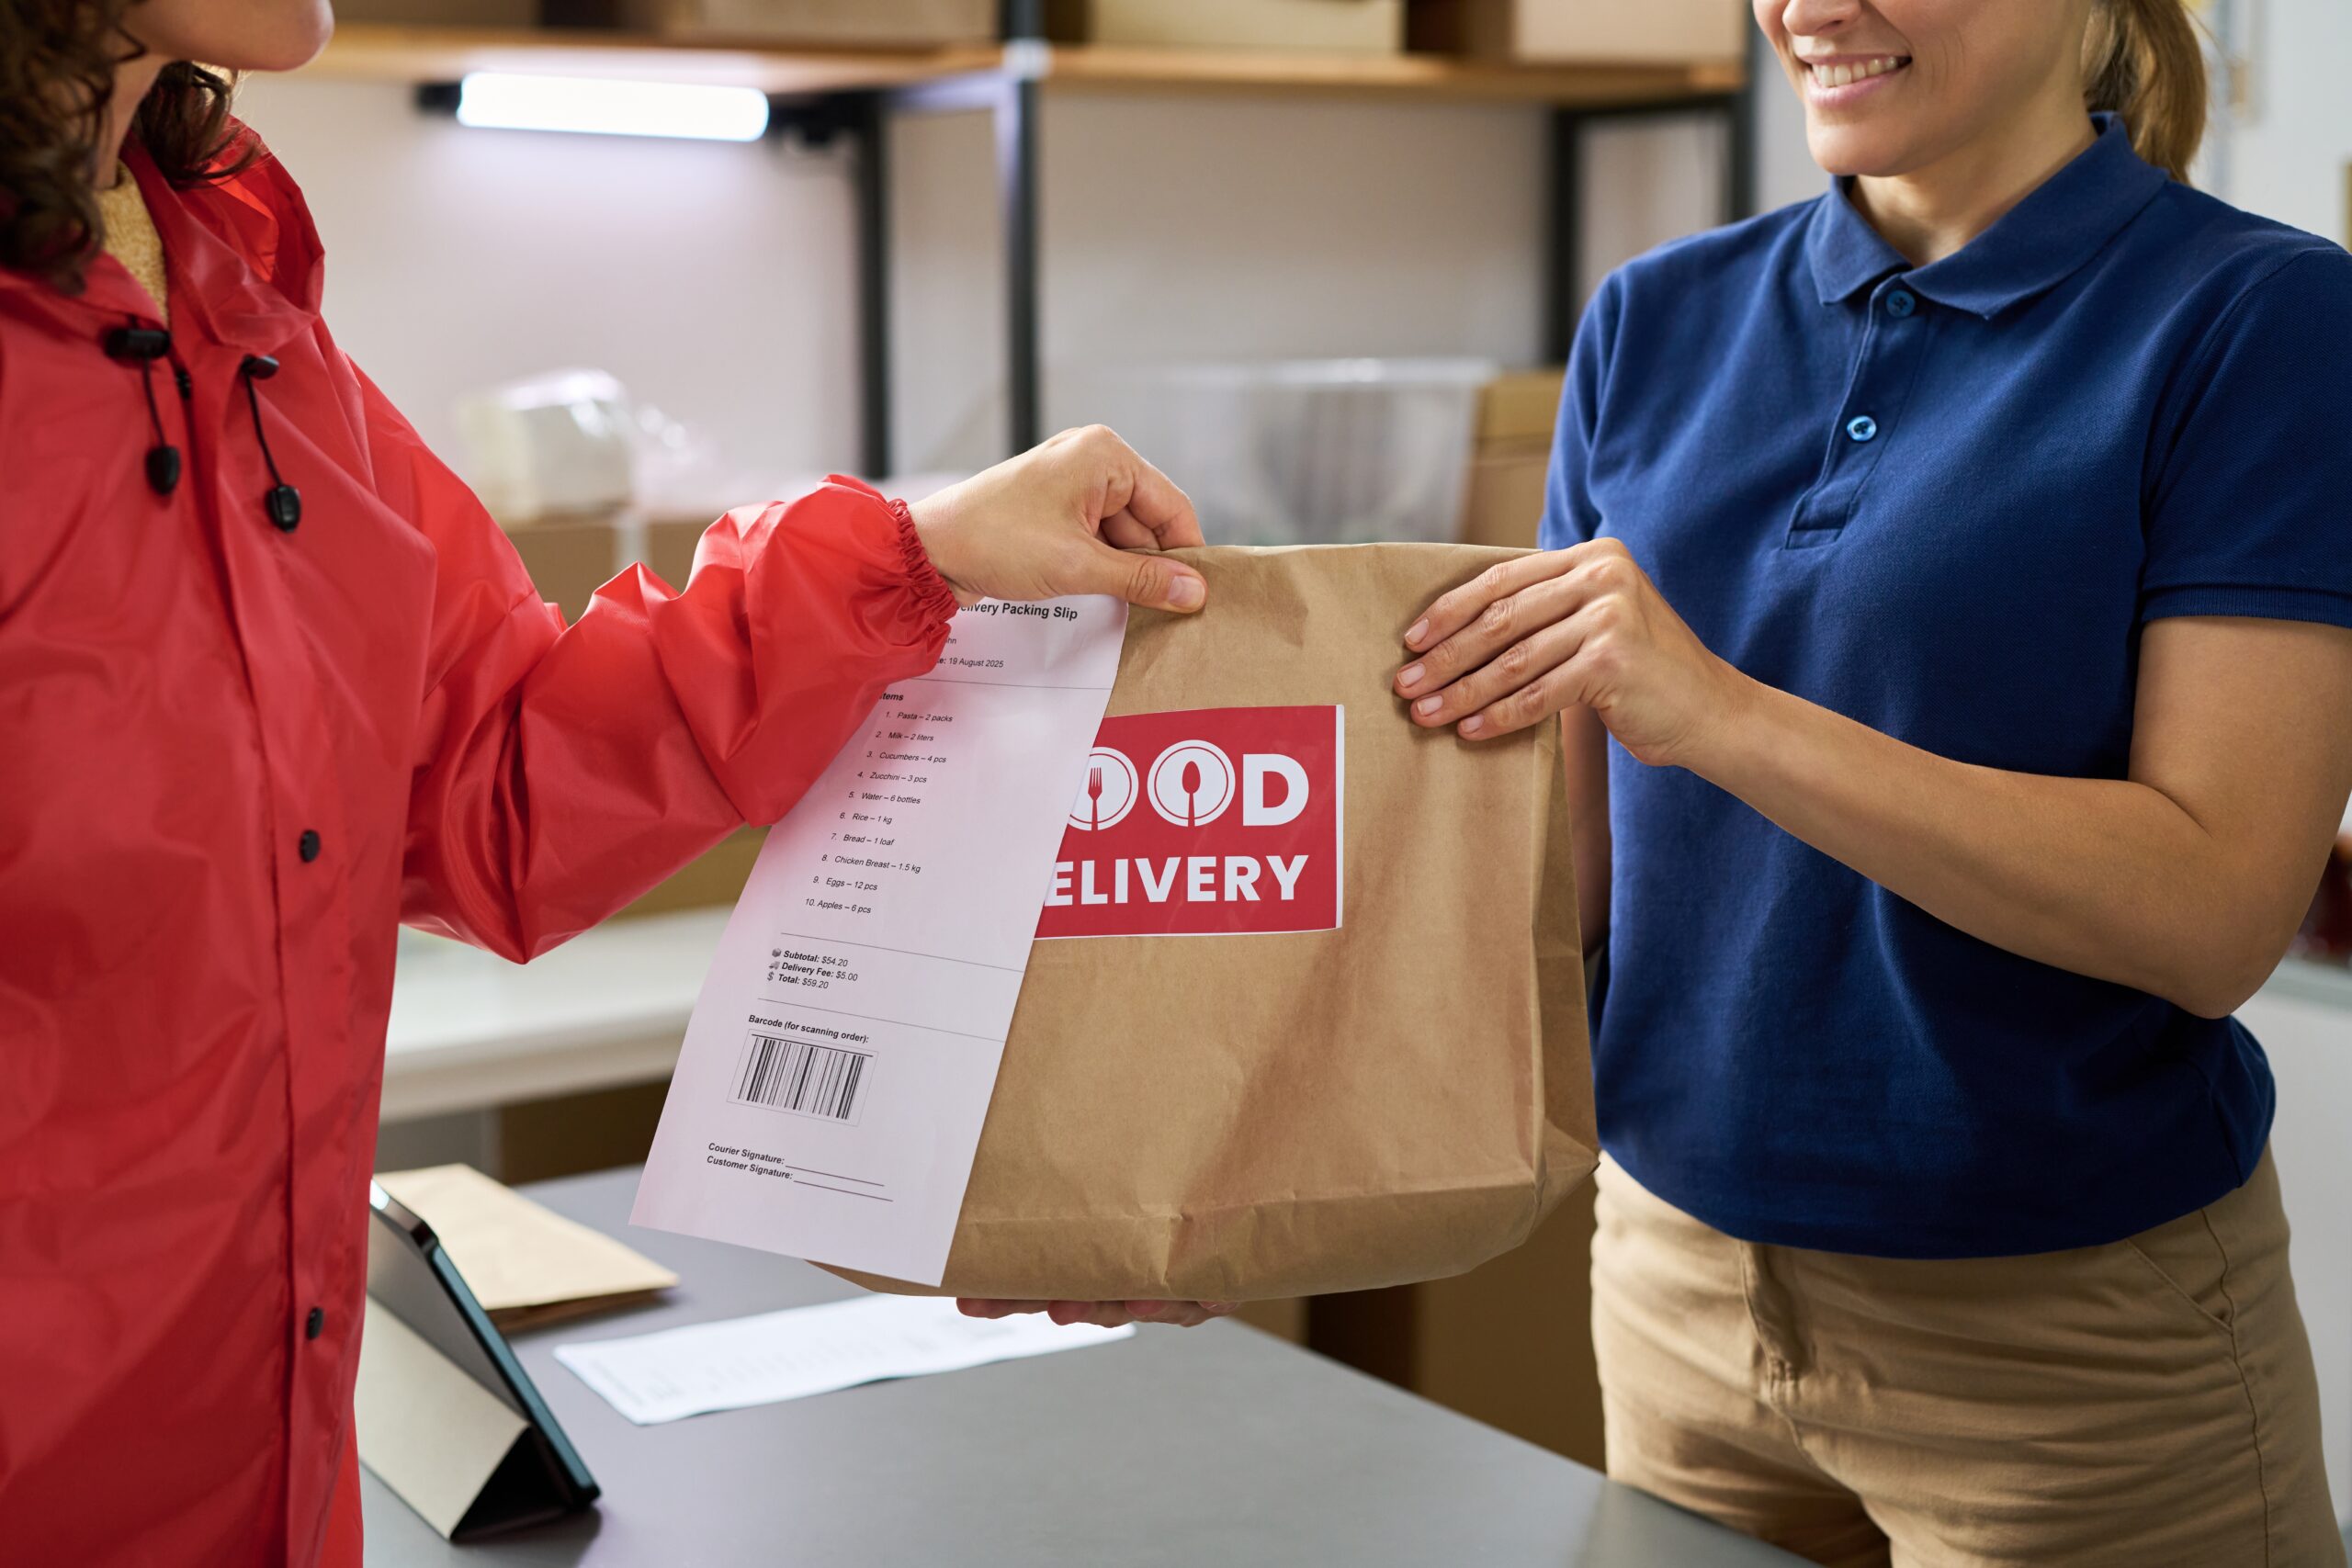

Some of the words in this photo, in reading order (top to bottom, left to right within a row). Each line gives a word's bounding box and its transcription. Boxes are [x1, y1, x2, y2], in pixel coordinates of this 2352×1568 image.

[959, 603, 1000, 616] eivery
[1001, 603, 1049, 619] Packing
[1053, 606, 1078, 621] Slip
[949, 657, 958, 665] 19
[959, 658, 984, 668] August
[985, 660, 1004, 669] 2025
[879, 692, 904, 702] tems
[897, 712, 918, 720] Pasta
[931, 715, 954, 723] packs
[888, 731, 902, 739] Milk
[917, 734, 934, 742] liters
[879, 751, 920, 761] Cucumbers
[933, 756, 947, 764] pcs
[869, 772, 900, 781] Zucchini
[1067, 739, 1310, 830] OOD
[861, 792, 883, 801] Water
[896, 795, 921, 805] bottles
[852, 813, 869, 821] Rice
[882, 816, 893, 825] kg
[843, 833, 865, 843] Bread
[879, 838, 895, 846] loaf
[834, 855, 865, 866] Chicken
[865, 859, 890, 869] Breast
[899, 863, 910, 872] 1.5
[910, 863, 922, 874] kg
[826, 877, 845, 888] Eggs
[854, 881, 864, 889] 12
[864, 883, 878, 891] pcs
[1044, 854, 1309, 907] ELIVERY
[805, 897, 816, 907] 10.
[817, 899, 842, 910] Apples
[851, 904, 857, 912] 6
[857, 906, 872, 914] pcs
[783, 950, 820, 963] Subtotal:
[821, 955, 849, 967] $54.20
[781, 962, 815, 976] Delivery
[816, 967, 834, 978] Fee:
[835, 971, 858, 982] $5.00
[778, 973, 801, 985] Total:
[801, 977, 830, 989] $59.20
[748, 1014, 783, 1028] Barcode
[784, 1021, 799, 1031] (for
[800, 1024, 840, 1040] scanning
[841, 1032, 869, 1044] order):
[707, 1142, 741, 1156] Courier
[741, 1148, 786, 1166] Signature:
[707, 1155, 749, 1171] Customer
[749, 1163, 794, 1180] Signature:
